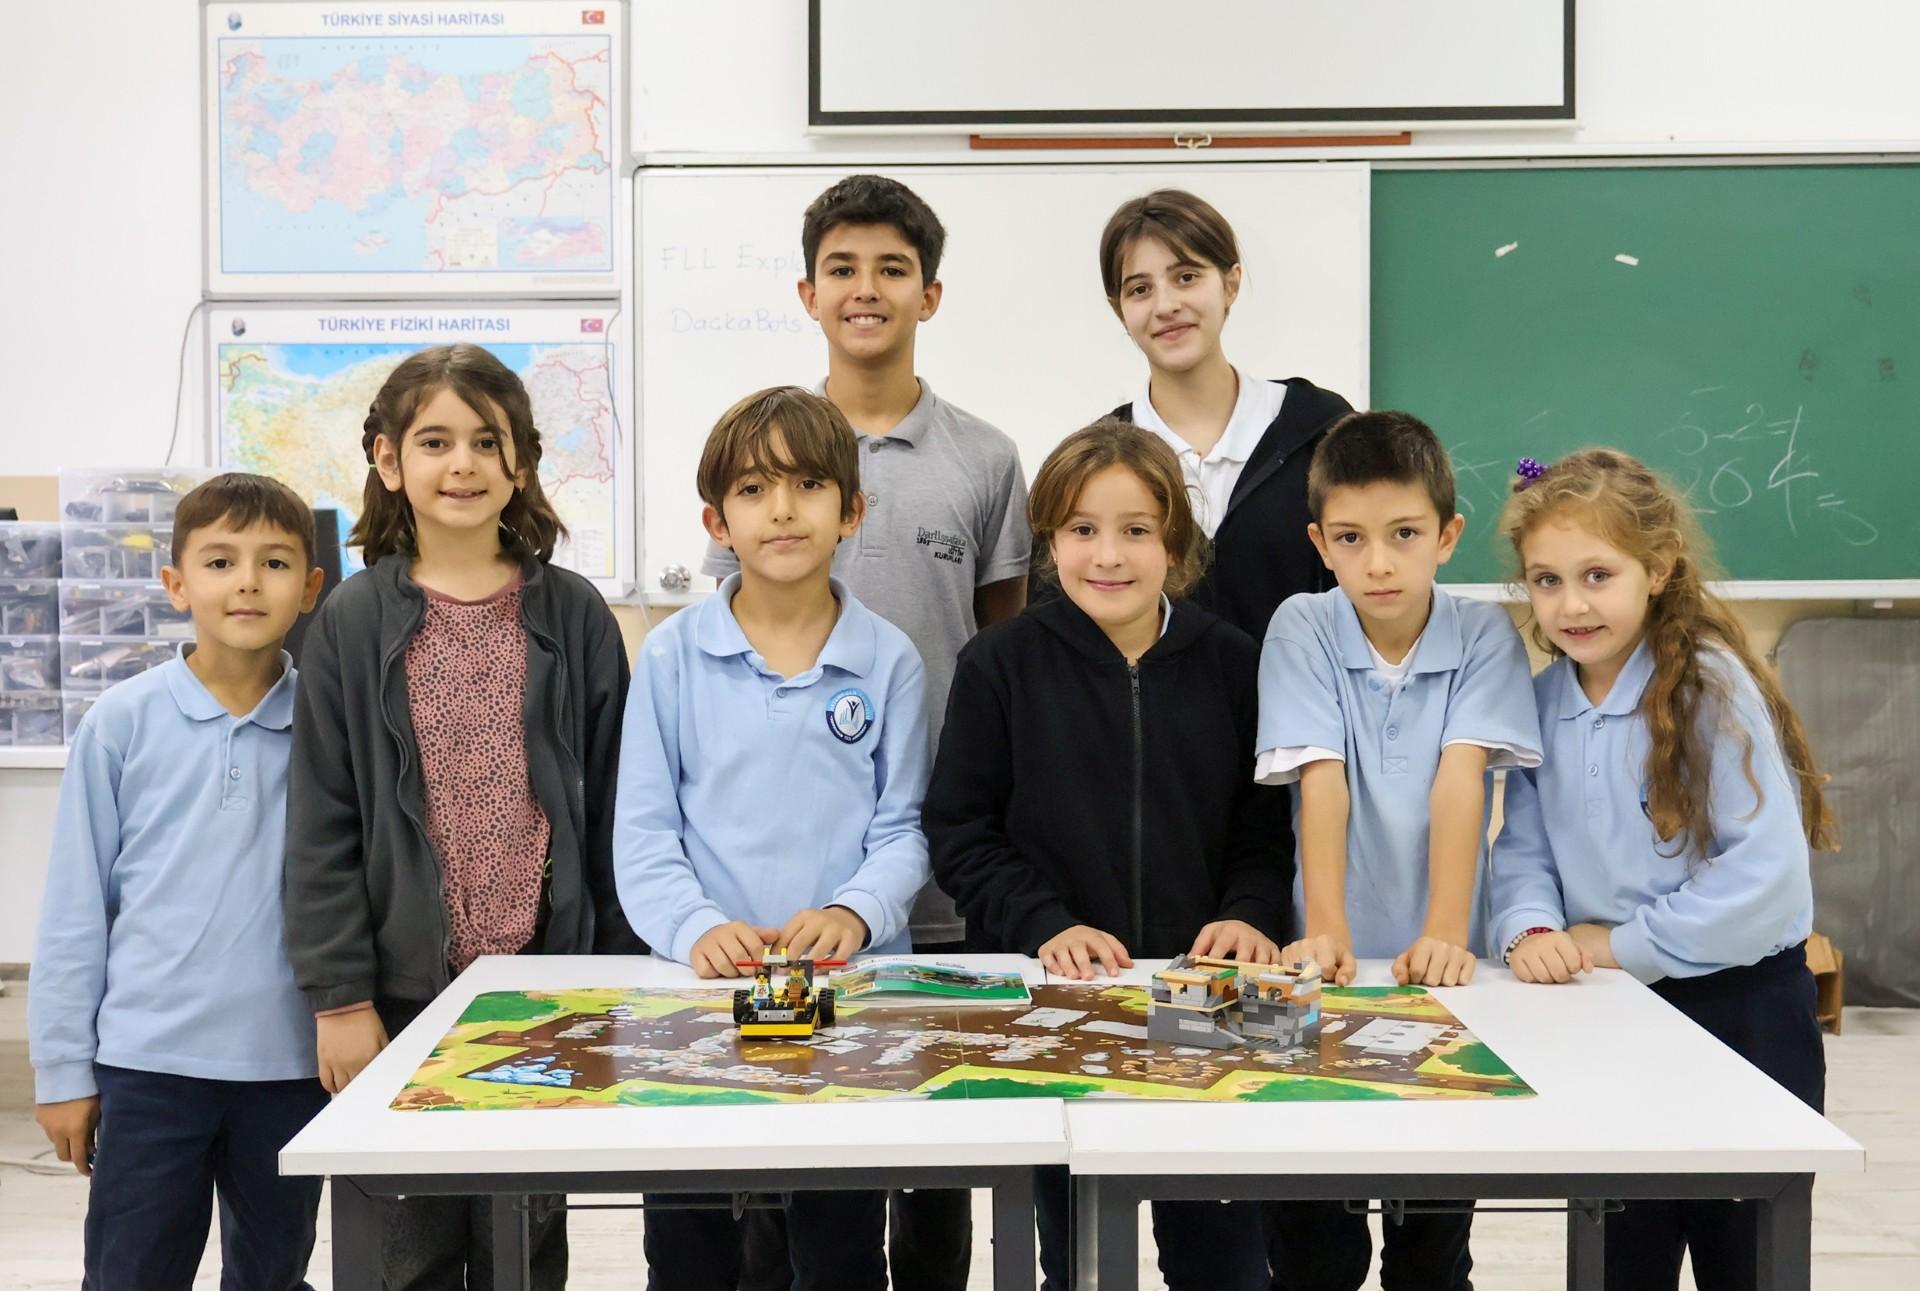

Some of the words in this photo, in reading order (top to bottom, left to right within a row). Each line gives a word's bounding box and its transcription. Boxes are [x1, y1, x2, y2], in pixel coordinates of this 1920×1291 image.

[321, 12, 384, 27] TÜRKİYE
[388, 11, 434, 26] SİYASİ
[438, 11, 505, 26] HARİTASI
[660, 246, 718, 272] FLL
[318, 316, 386, 332] TÜRKİYE
[391, 316, 434, 332] FİZİKİ
[438, 316, 511, 332] HARİTASI
